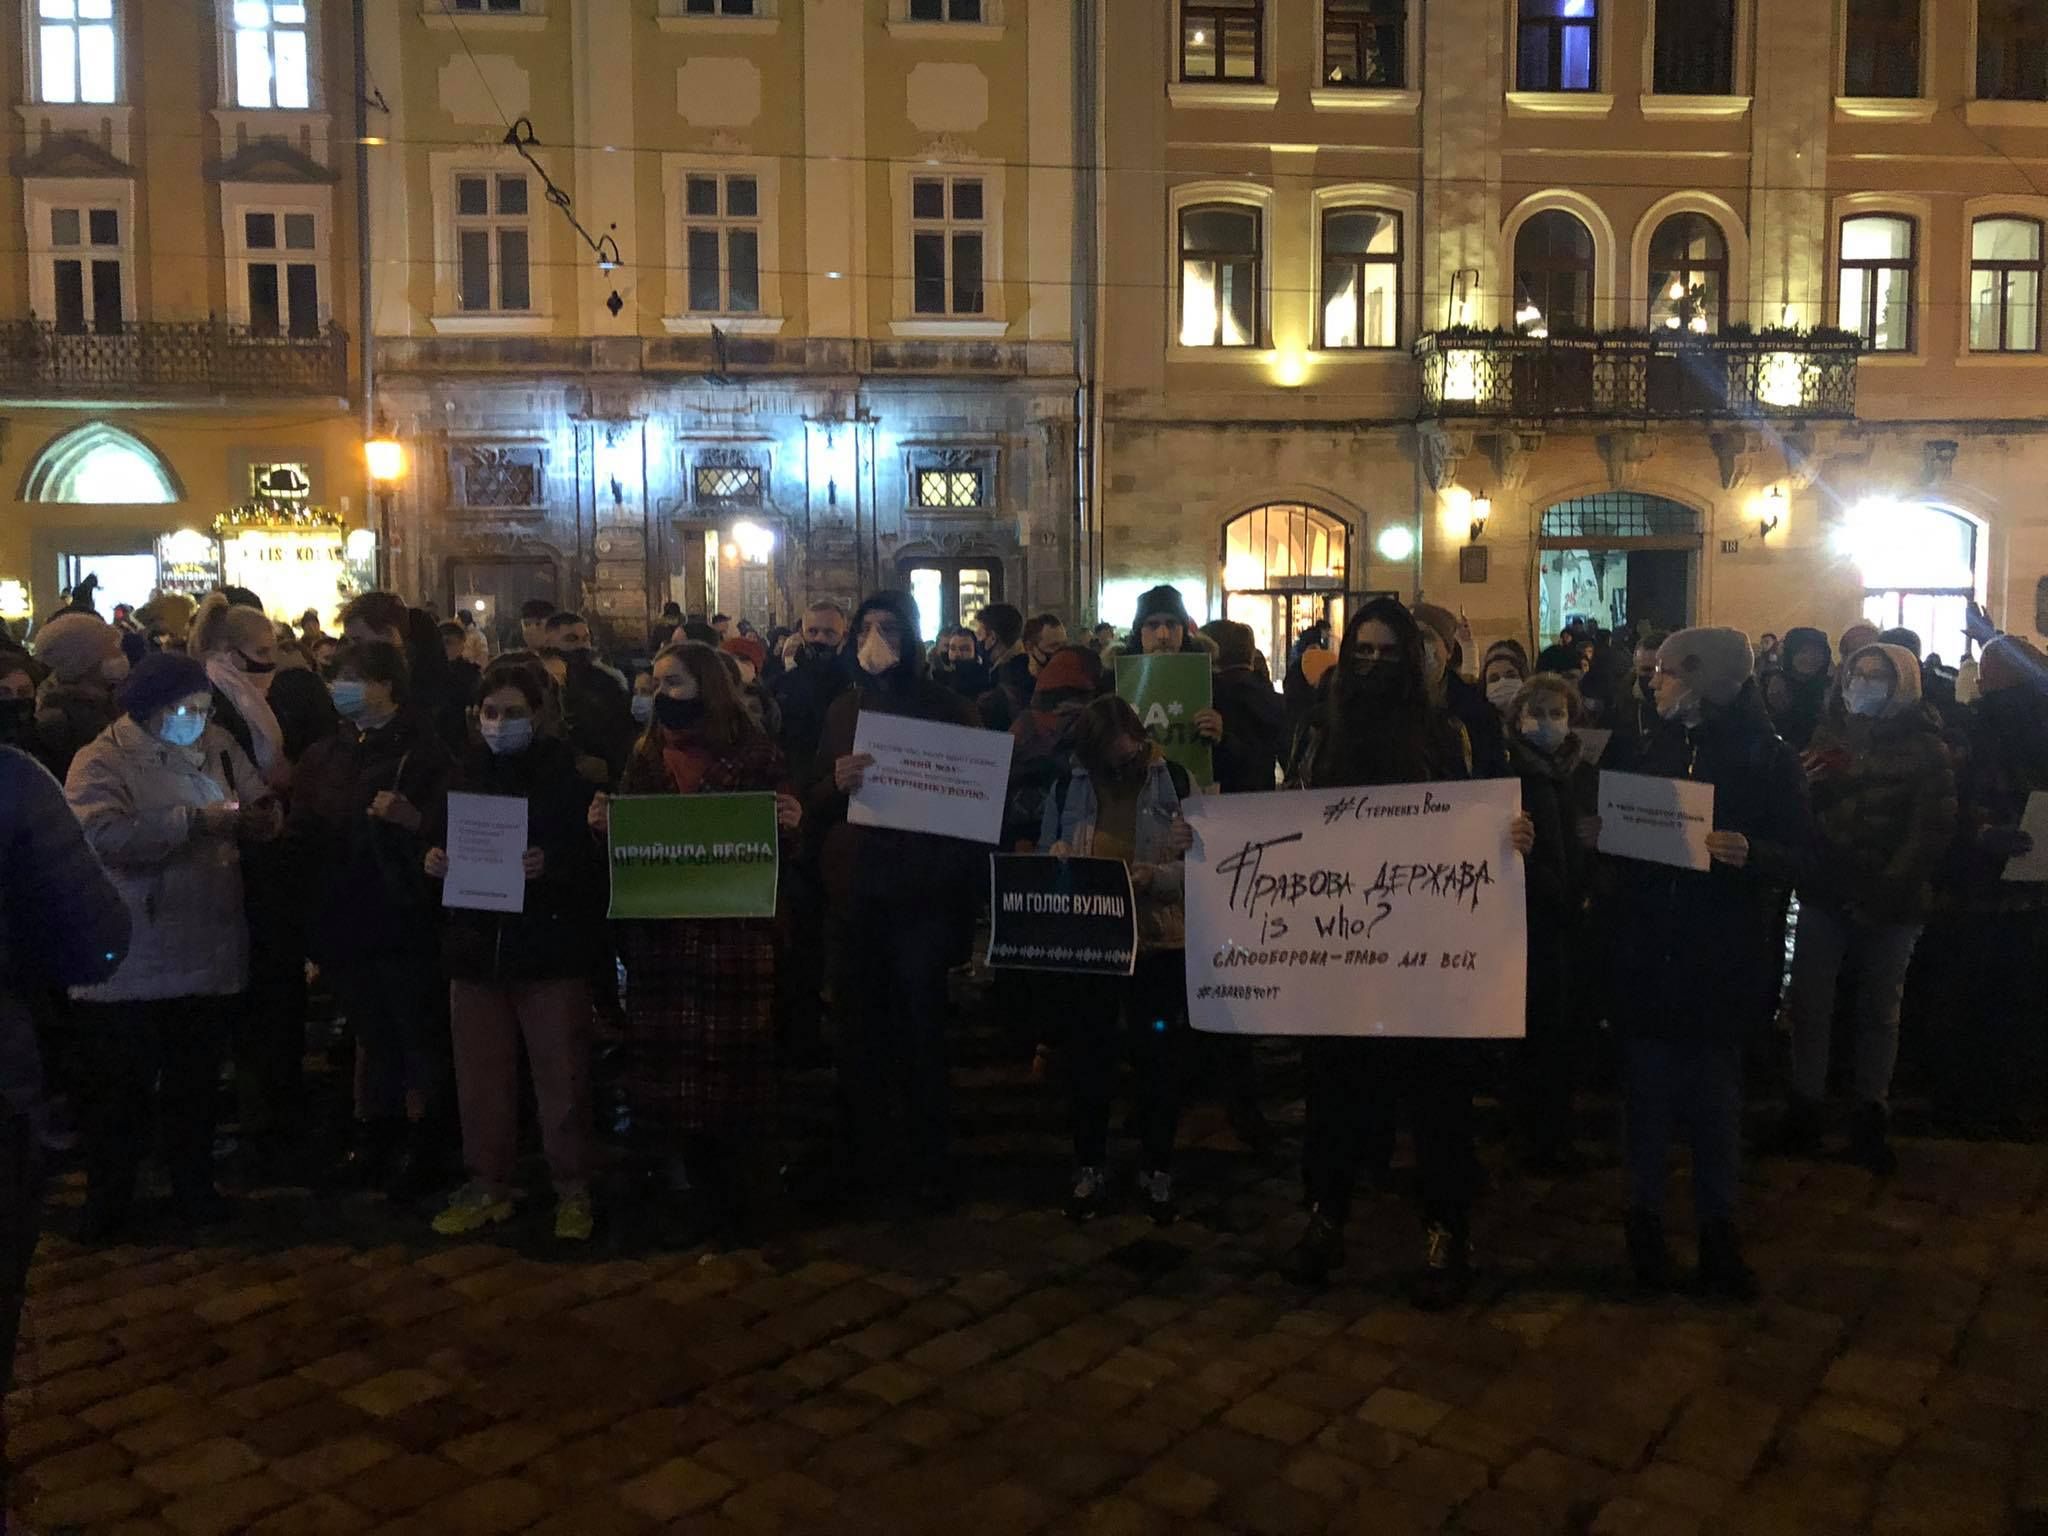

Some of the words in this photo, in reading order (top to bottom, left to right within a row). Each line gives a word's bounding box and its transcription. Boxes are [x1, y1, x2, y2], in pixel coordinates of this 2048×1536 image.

[1003, 893, 1023, 912] МИ
[1027, 893, 1070, 914] ГОЛОС
[1073, 894, 1125, 918] ВУЛИЦІ
[1261, 912, 1288, 944] is
[1315, 902, 1392, 940] who?
